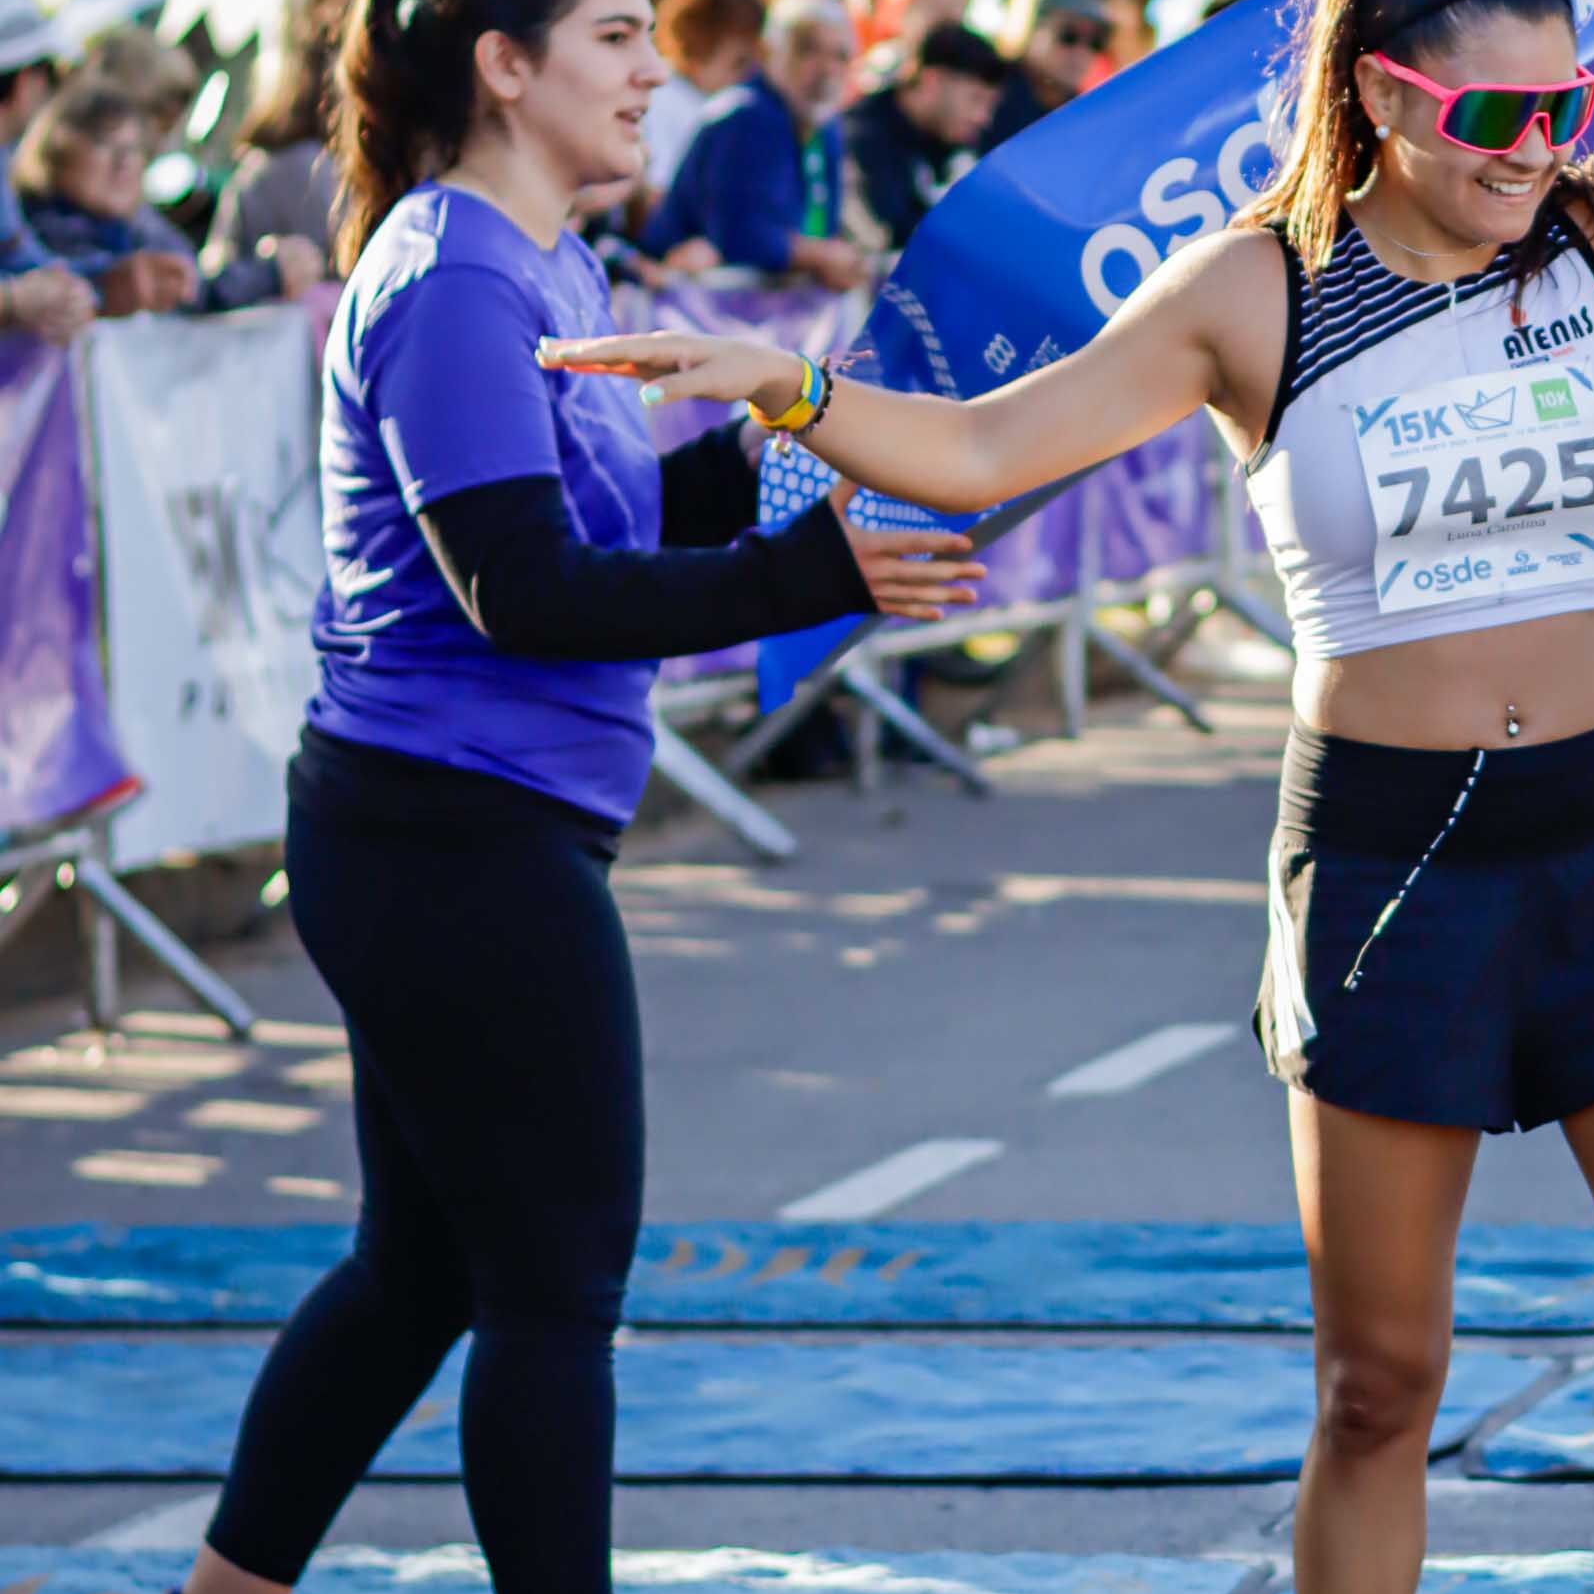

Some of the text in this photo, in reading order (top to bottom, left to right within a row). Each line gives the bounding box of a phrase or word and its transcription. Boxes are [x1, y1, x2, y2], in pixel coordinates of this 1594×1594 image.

[1536, 388, 1570, 410] 10K
[1383, 405, 1453, 447] 15K
[1413, 556, 1492, 592] osde
